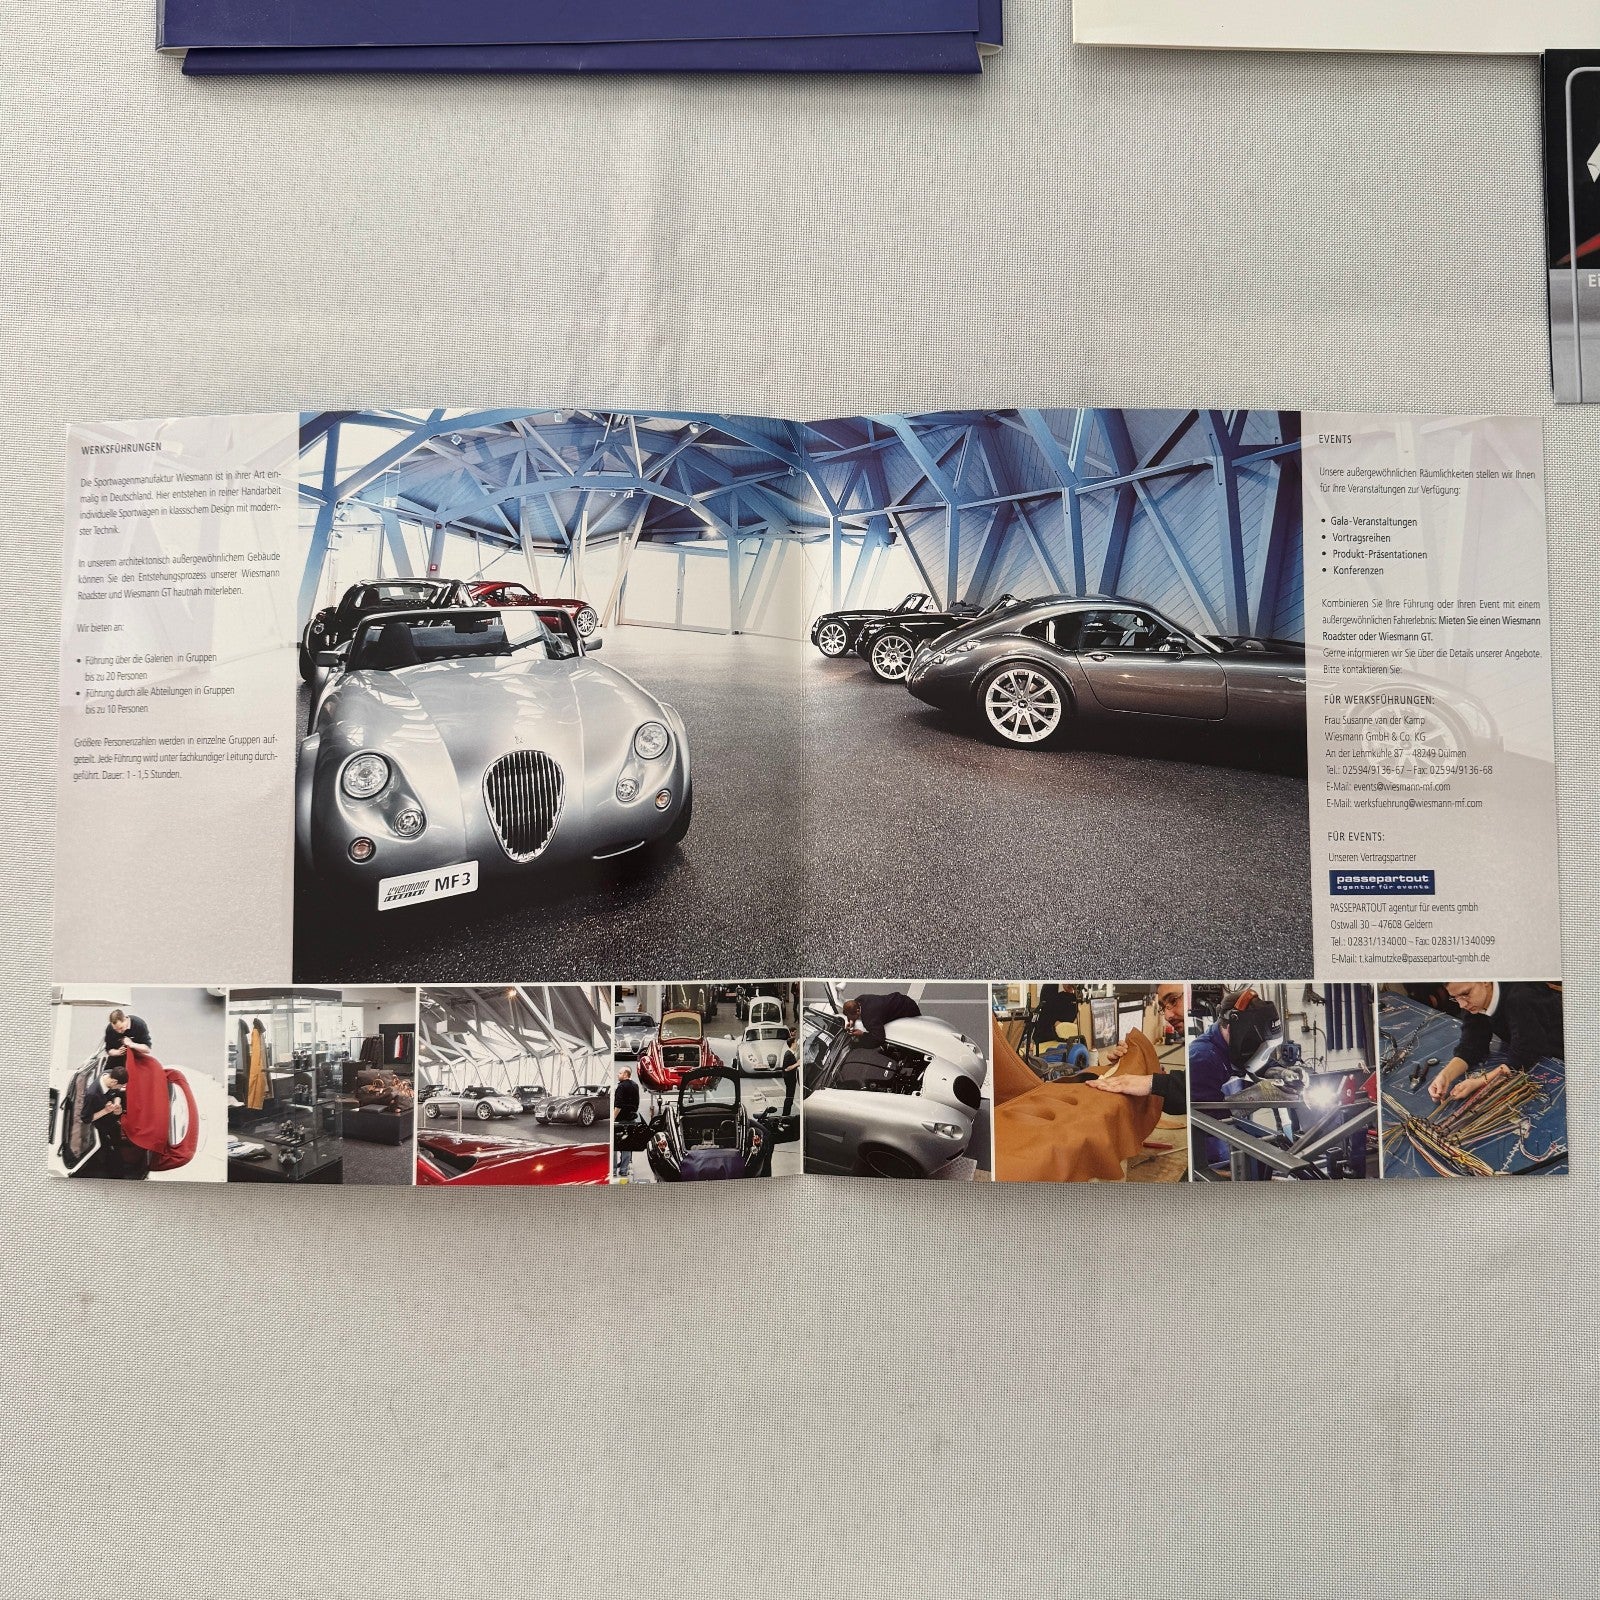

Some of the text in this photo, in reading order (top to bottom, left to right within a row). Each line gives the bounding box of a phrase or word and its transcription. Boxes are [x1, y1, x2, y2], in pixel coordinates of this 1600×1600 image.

[1319, 435, 1352, 444] EVENTS
[81, 442, 162, 455] WERKSFÜHRUNGEN
[80, 478, 92, 487] Die
[94, 474, 174, 488] Sportwagenmanufaktur
[176, 473, 213, 482] Wiesmann
[215, 472, 224, 480] ist
[226, 471, 233, 480] in
[254, 470, 265, 479] Art
[267, 470, 281, 478] ein-
[1320, 467, 1536, 480] Unsere außergewöhnlichen Räumlichkeiten stellen wir Ihnen
[110, 487, 281, 502] Deutschland. Hier entstehen in reiner Handarbeit
[1320, 483, 1330, 493] für
[1348, 484, 1406, 495] Veranstaltungen
[1408, 486, 1419, 494] zur
[1421, 485, 1461, 496] Verfügung:
[80, 503, 281, 520] individuelle Sportwagen in klassischem Design mit modern-
[1330, 516, 1418, 528] Gala-Veranstaltungen
[1333, 533, 1391, 544] Vortragsreihen
[78, 552, 280, 567] In unserem architektonisch außergewöhnlichem Gebäude
[1333, 549, 1428, 560] Produkt-Präsentationen
[1333, 565, 1384, 575] Konferenzen
[78, 586, 243, 600] Roadster und Wiesmann GT hautnah miterleben.
[1322, 599, 1541, 610] Kombinieren Sie Ihre Führung oder Ihren Event mit einem
[1322, 615, 1541, 627] außergewöhnlichen Fahrerlebnis: Mieten Sie einen Wiesmann
[1322, 632, 1433, 642] Roadster oder Wiesmann GT.
[85, 653, 217, 666] Führung über die Galerien in Gruppen
[1323, 648, 1542, 660] Gerne informieren wir Sie über die Details unserer Angebote.
[1323, 664, 1402, 675] Bitte kontaktieren Sie:
[85, 673, 95, 681] bis
[107, 672, 116, 681] 20
[117, 671, 147, 680] Personen
[86, 685, 235, 699] Führung durch alle Abteilungen in Gruppen
[1324, 694, 1435, 705] FÜR WERKSFÜHRUNGEN:
[86, 705, 95, 714] bis
[107, 705, 116, 714] 10
[118, 704, 148, 713] Personen
[1324, 716, 1426, 727] Frau Susanne van der Kamp
[1324, 732, 1364, 742] Wiesmann
[1365, 732, 1389, 742] GmbH
[1415, 732, 1426, 742] KG
[1325, 748, 1336, 758] An
[1338, 748, 1350, 758] der
[1393, 748, 1404, 758] 87
[1412, 749, 1436, 758] 48249
[1438, 748, 1467, 758] Dülmen
[1342, 765, 1405, 776] 02594/9136-67
[1430, 765, 1493, 775] 02594/9136-68
[1326, 782, 1451, 793] E-Mail: events@wiesmann-mf.com
[1326, 798, 1482, 810] E-Mail: werksfuehrung@wiesmann-mf.com
[1328, 831, 1385, 842] FÜR EVENTS:
[1328, 852, 1416, 864] Unseren Vertragspartner
[1337, 875, 1429, 884] passepartout
[1330, 902, 1478, 914] PASSEPARTOUT agentur für events gmbh
[1330, 919, 1433, 930] Ostwall 30 47608 Geldern
[1331, 936, 1495, 947] Tel.: 02831/134000 Fax: 02831/1340099
[1331, 953, 1491, 965] E-Mail: t.kalmutzke@passepartout-gmbh.de
